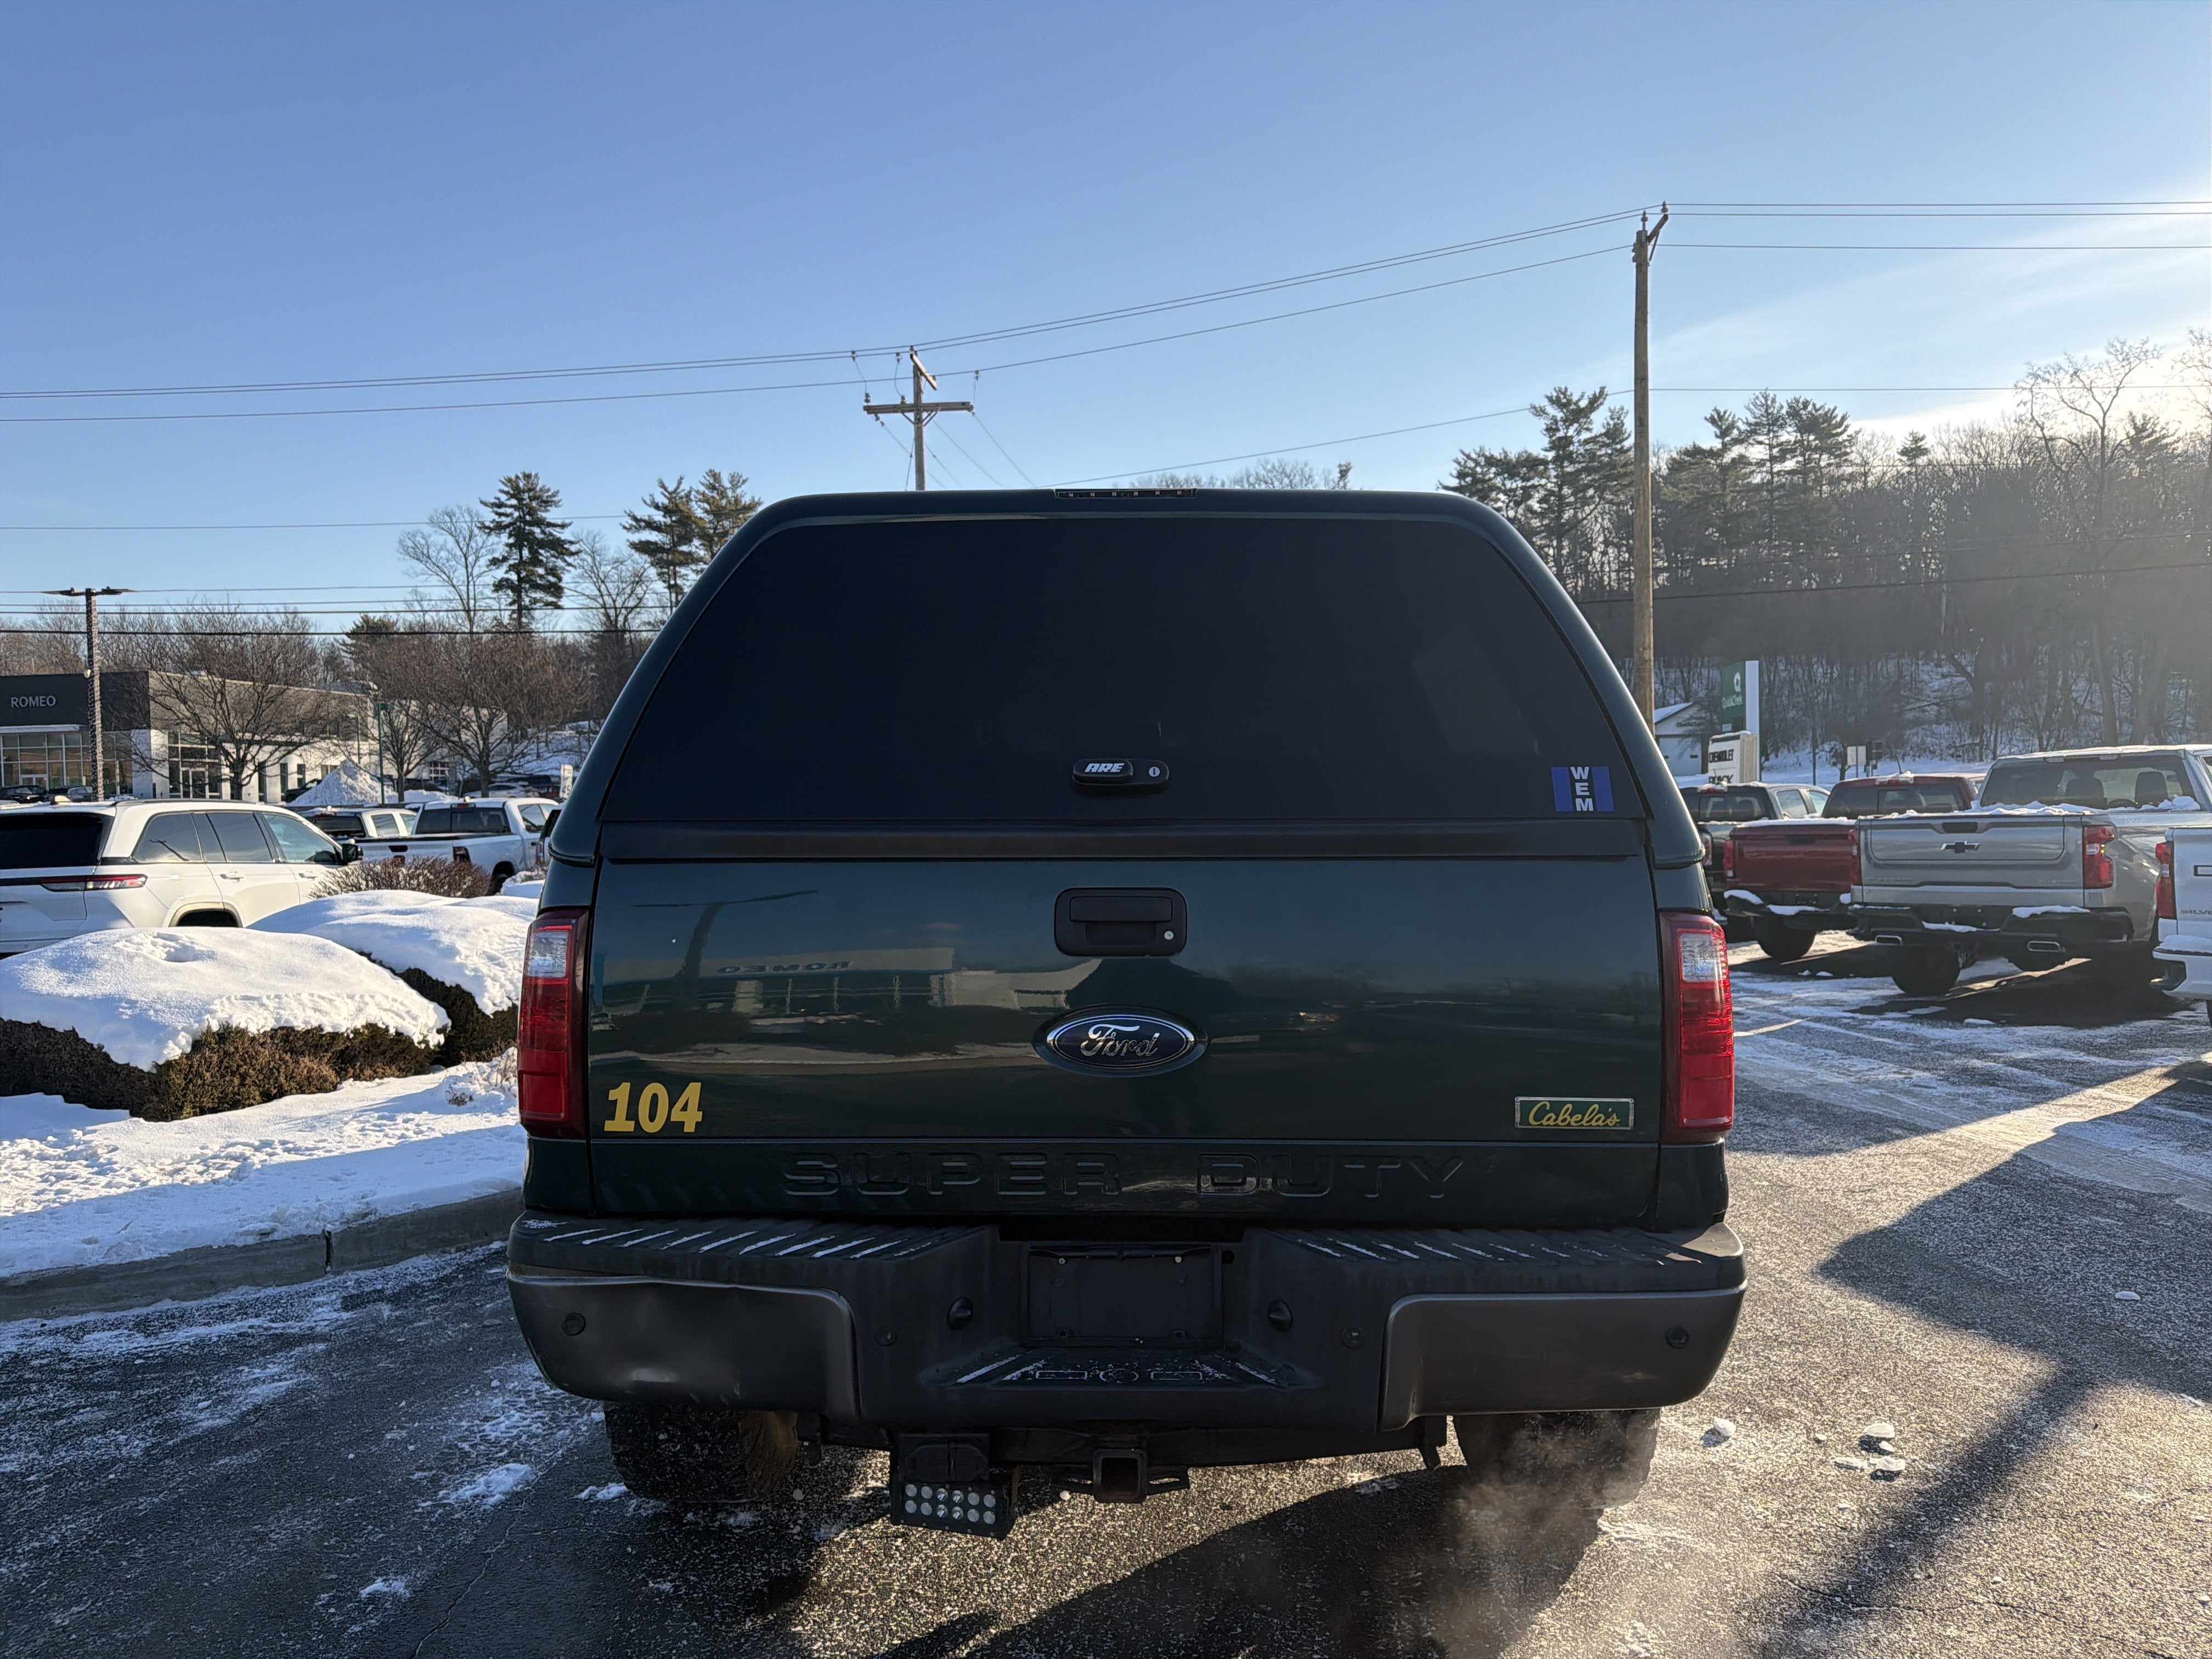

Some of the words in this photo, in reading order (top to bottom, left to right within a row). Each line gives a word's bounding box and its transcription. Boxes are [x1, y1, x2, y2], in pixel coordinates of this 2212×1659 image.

[11, 695, 56, 708] ROMEO
[1084, 763, 1125, 772] ARE
[1570, 766, 1594, 811] WEM
[1080, 1024, 1160, 1057] Ford
[604, 1082, 703, 1133] 104
[1529, 1101, 1621, 1126] Cabela's
[781, 1153, 1119, 1195] SUPER
[1197, 1154, 1464, 1199] DUTY
